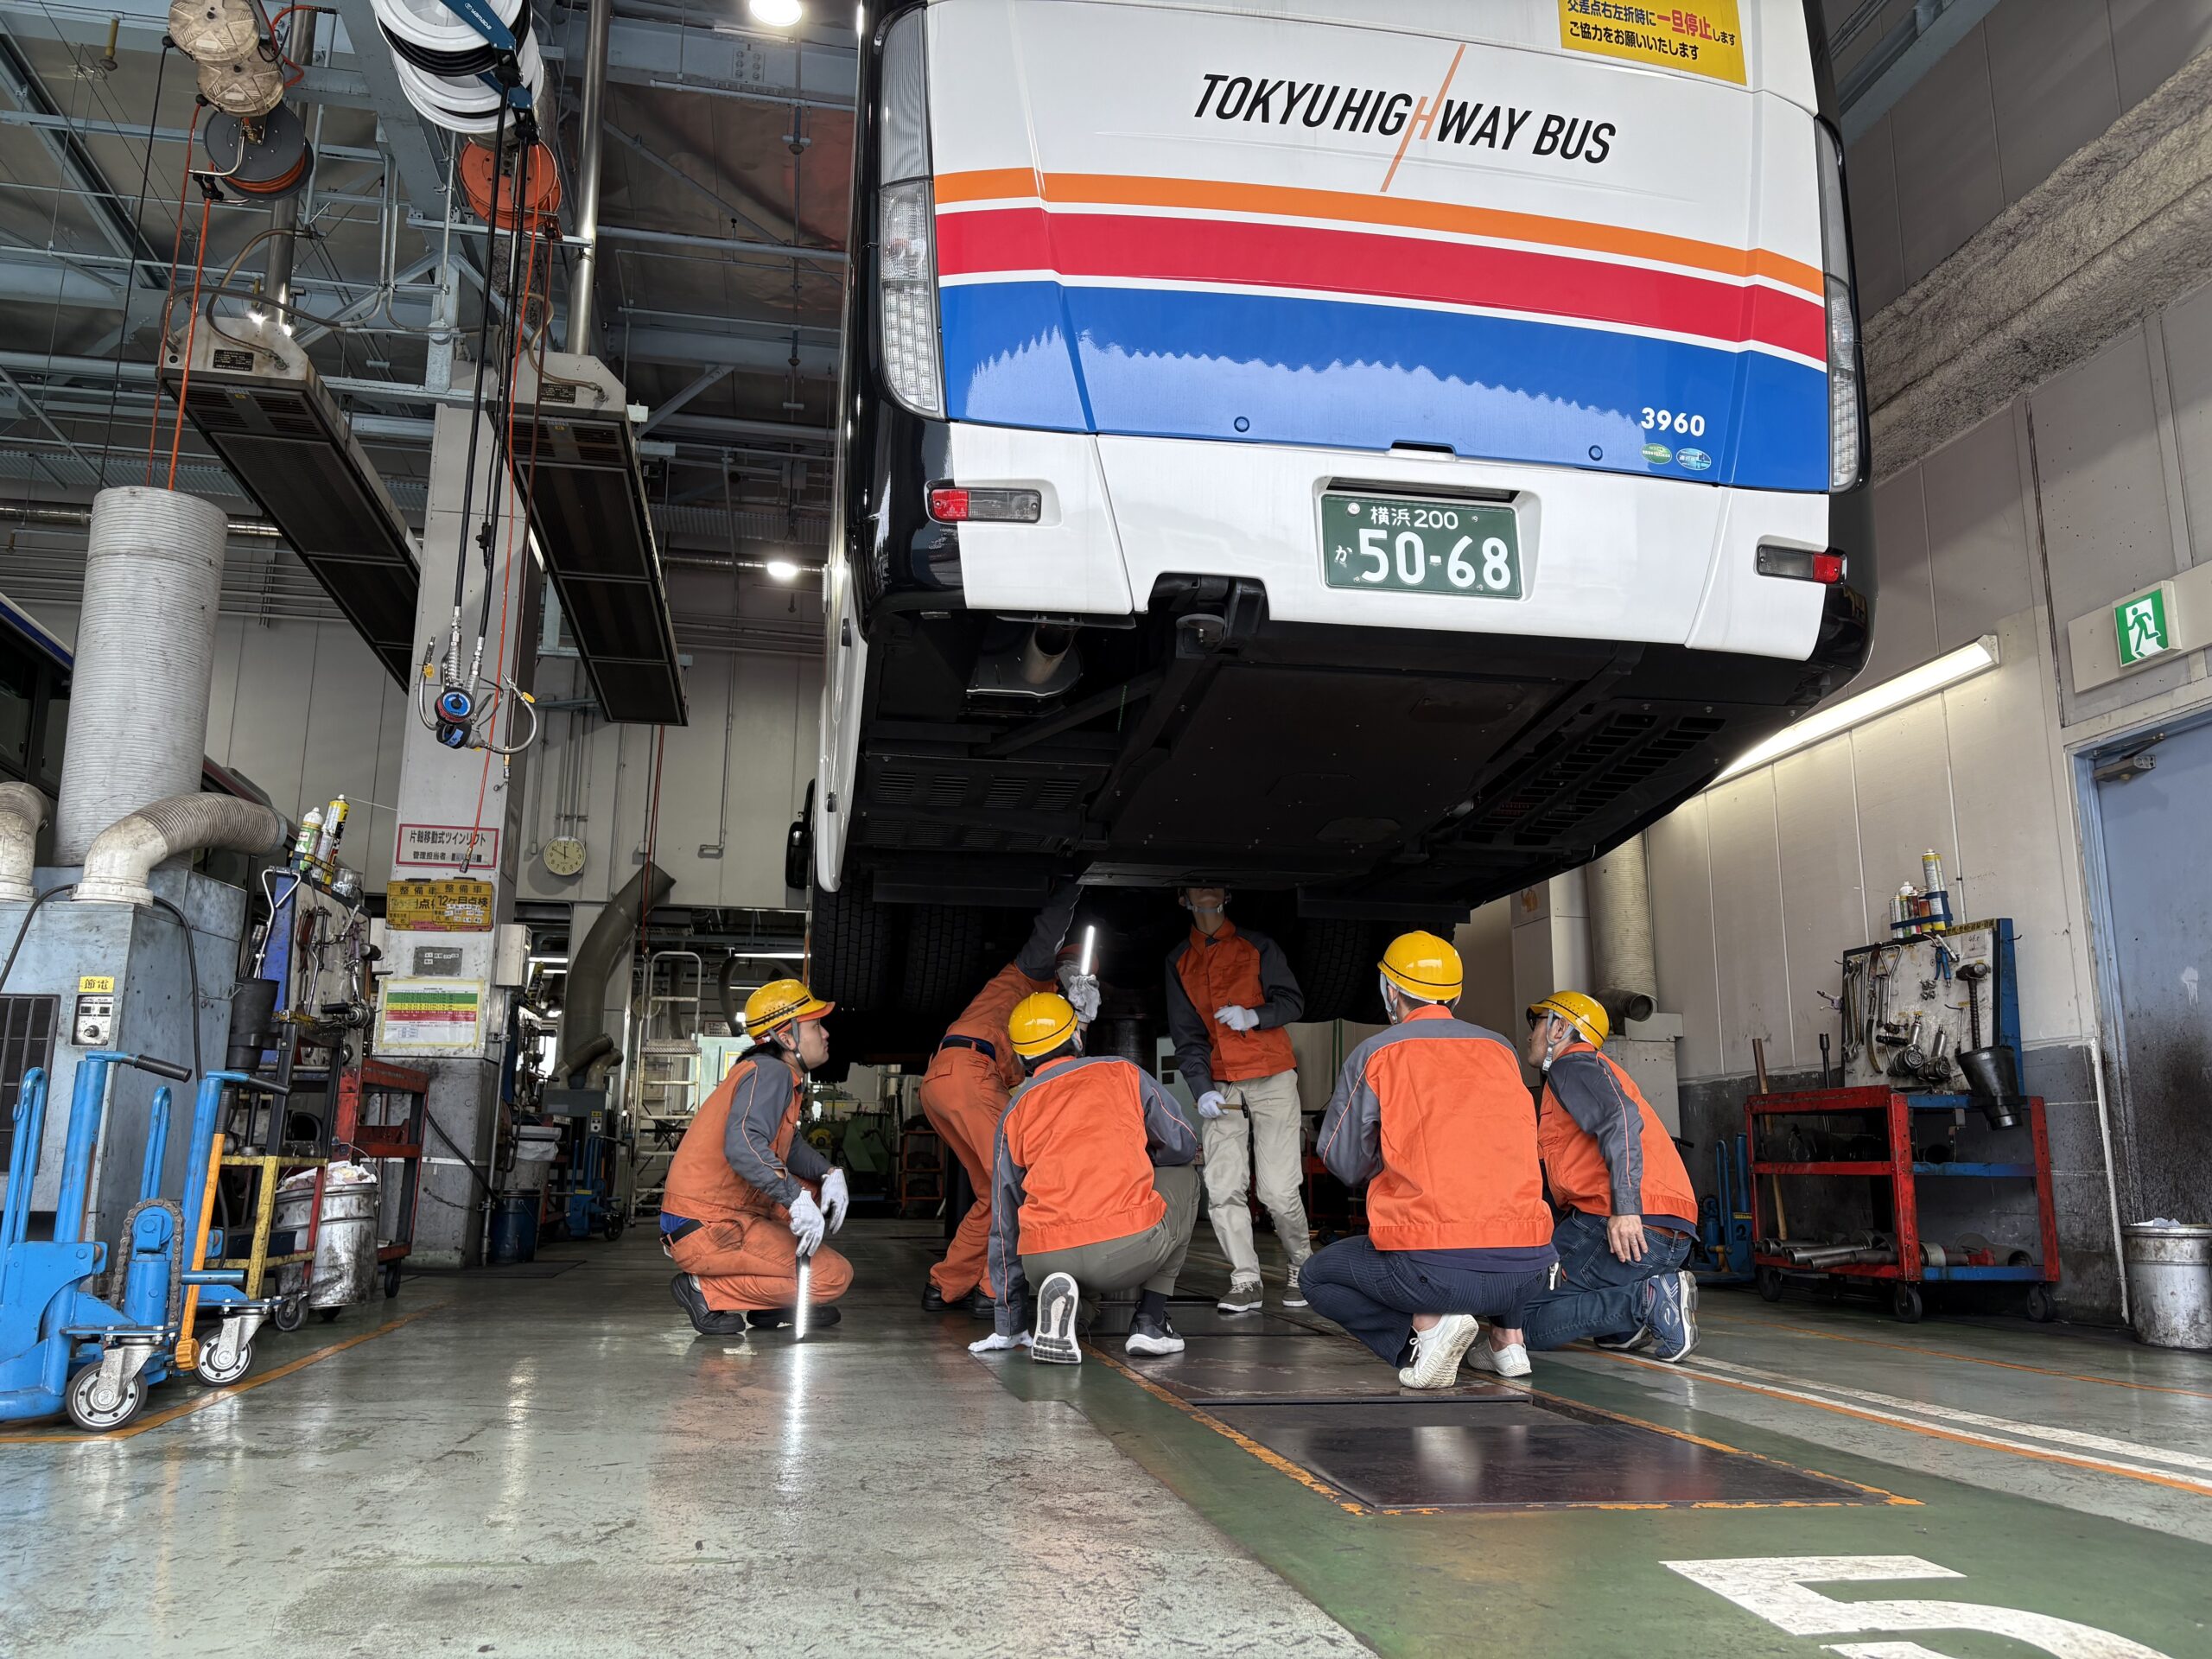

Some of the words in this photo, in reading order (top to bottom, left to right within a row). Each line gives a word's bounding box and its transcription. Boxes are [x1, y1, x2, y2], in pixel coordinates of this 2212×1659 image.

[1569, 21, 1700, 60] ご協力をお願いいたします
[1533, 113, 1616, 163] BUS
[1641, 407, 1705, 436] 3960
[1334, 544, 1352, 563] か
[1359, 528, 1511, 589] 50-68
